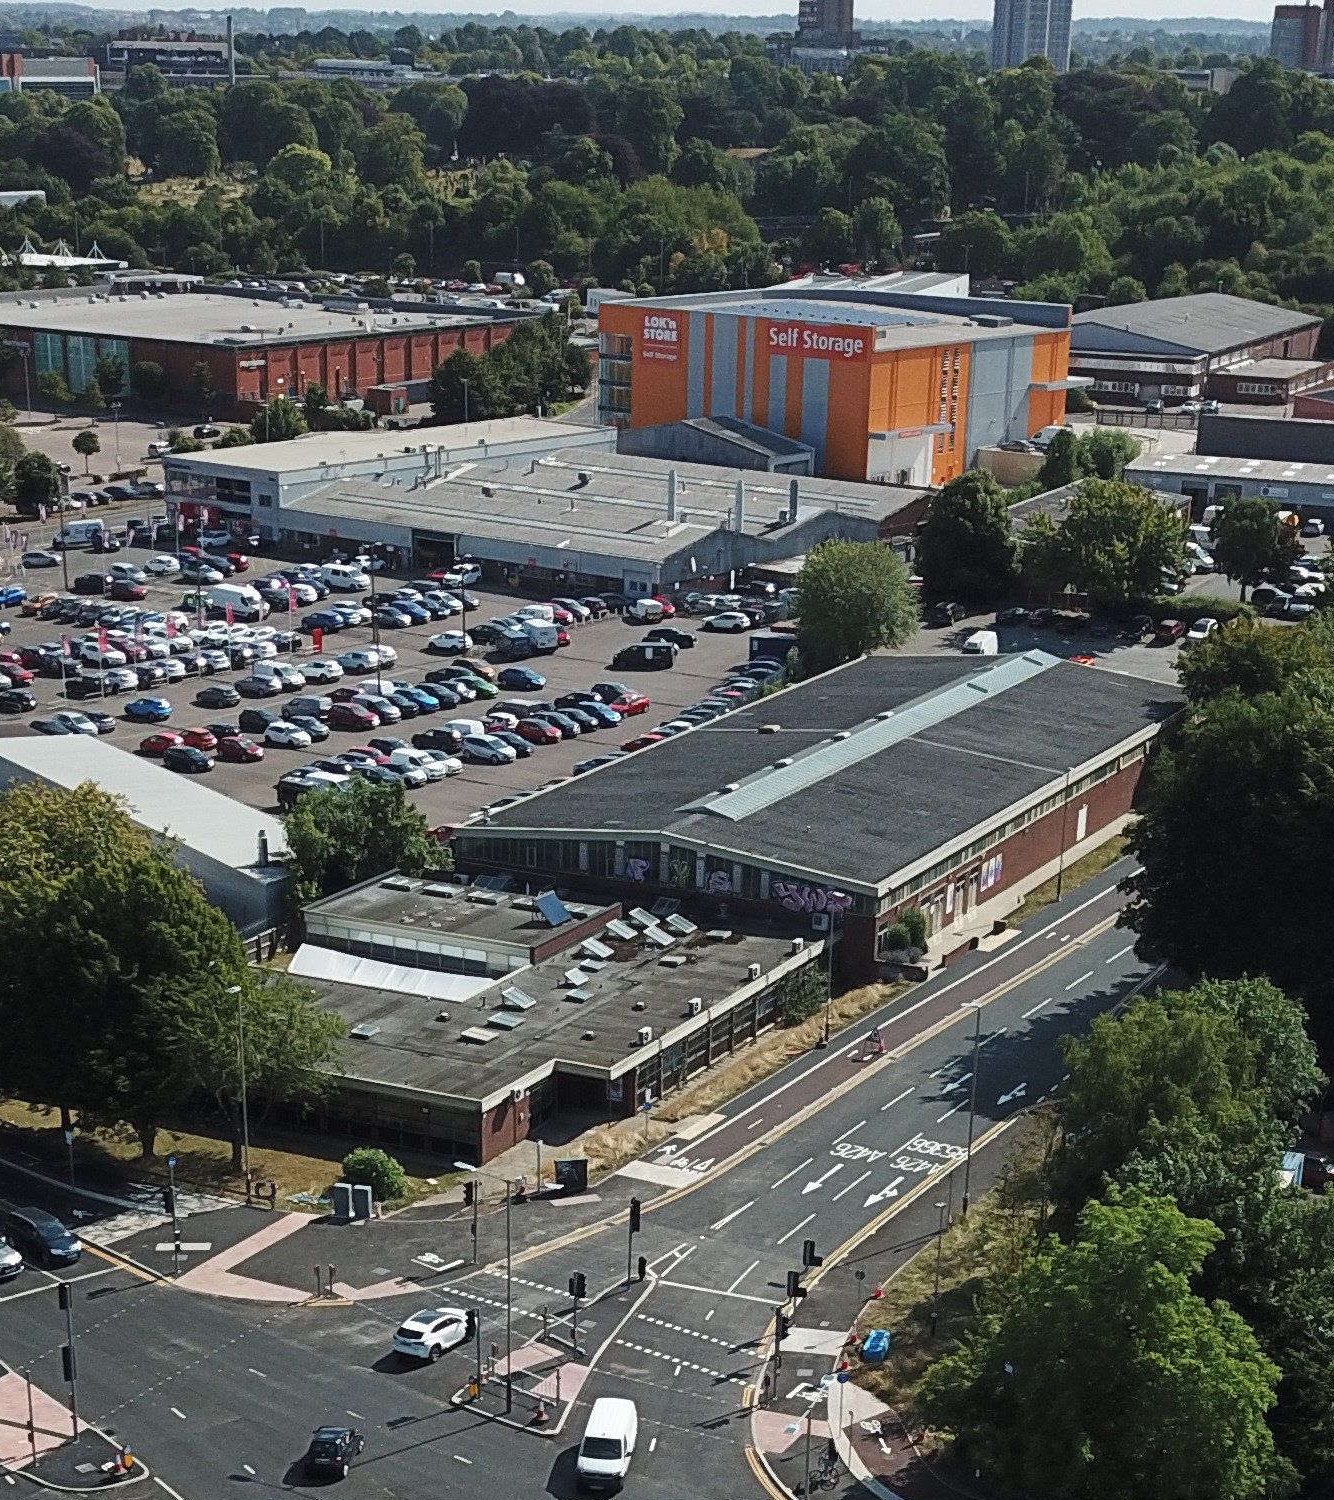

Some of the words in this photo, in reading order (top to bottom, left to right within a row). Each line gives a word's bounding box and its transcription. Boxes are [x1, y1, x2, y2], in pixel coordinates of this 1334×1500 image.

[644, 315, 677, 330] LOK'n
[643, 328, 678, 342] STORE
[769, 327, 799, 348] Self
[803, 330, 864, 358] Storage
[642, 350, 654, 359] Self
[654, 351, 678, 362] Storage
[830, 1142, 888, 1163] A426
[906, 1138, 969, 1161] B5366
[889, 1155, 944, 1175] A426
